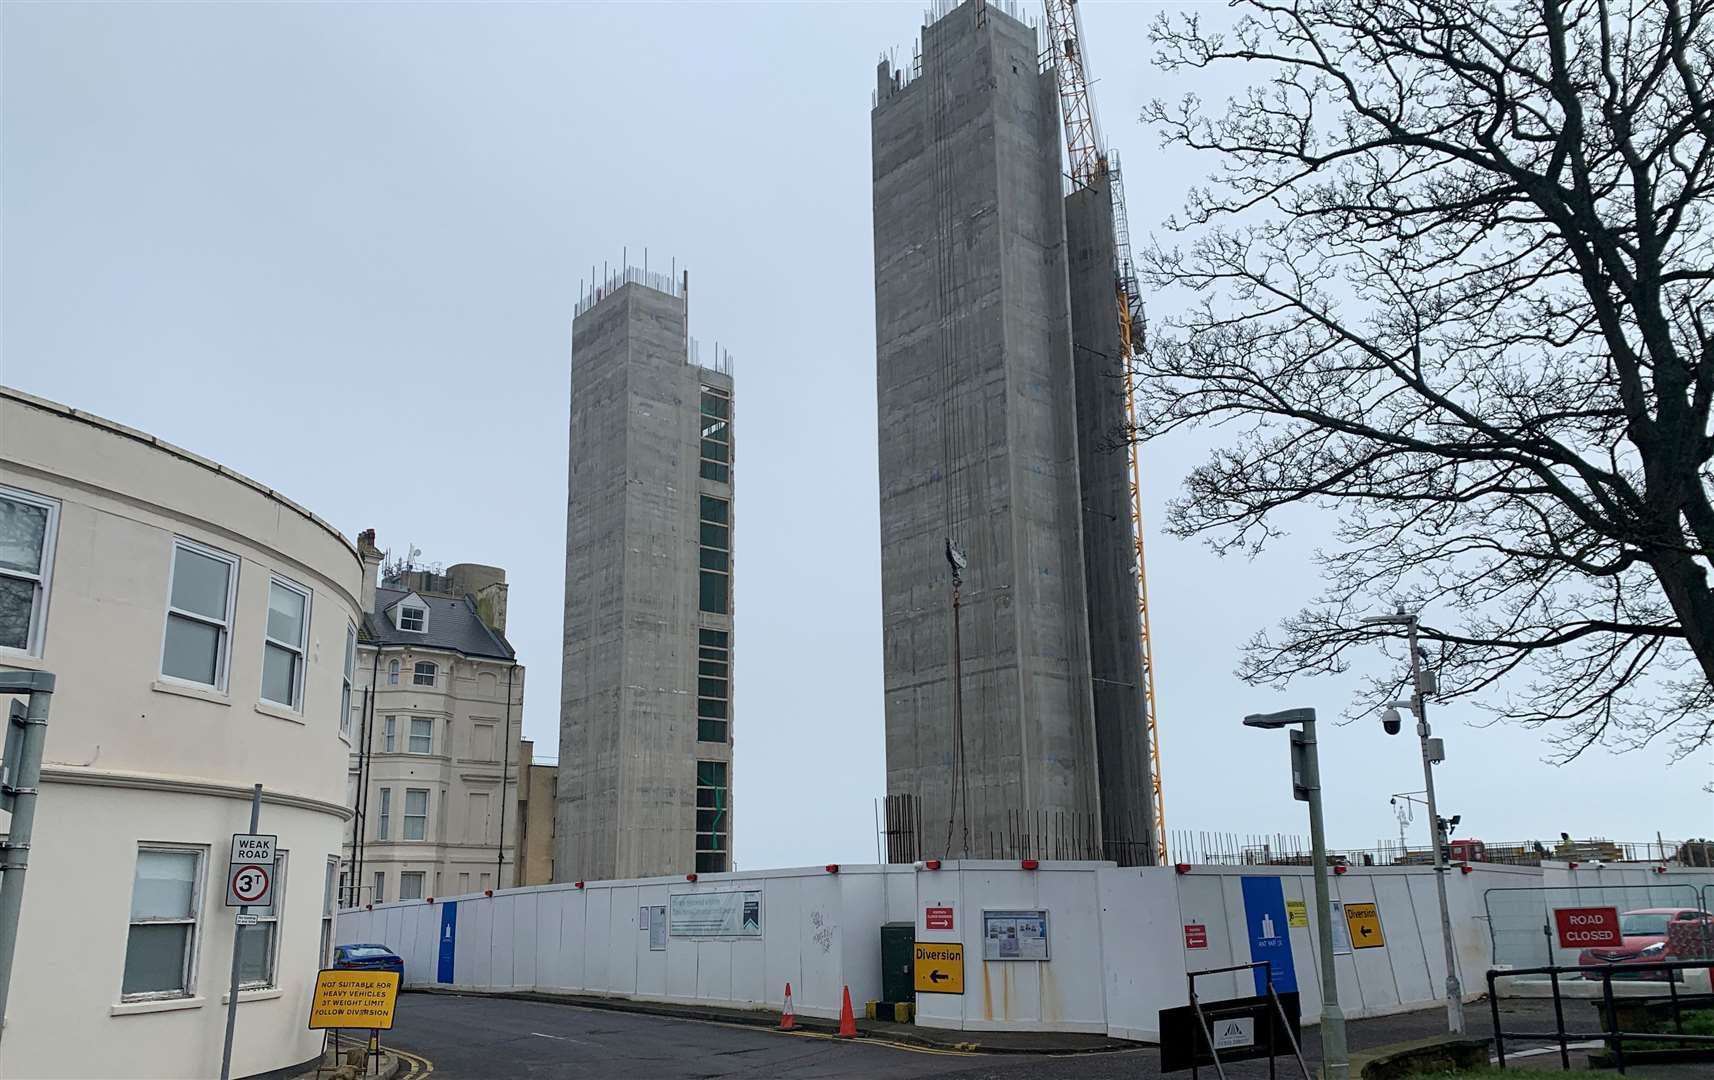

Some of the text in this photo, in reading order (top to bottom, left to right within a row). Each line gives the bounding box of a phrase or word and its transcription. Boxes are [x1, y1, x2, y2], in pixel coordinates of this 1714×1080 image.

[239, 840, 270, 849] WEAK
[238, 850, 268, 859] ROAD
[239, 875, 261, 892] 3T
[1347, 909, 1376, 919] Diversion
[1569, 914, 1604, 925] ROAD
[1566, 930, 1614, 941] CLOSED
[916, 948, 961, 960] Diversion
[338, 981, 375, 989] SUITABLE
[346, 1008, 389, 1016] DIVERSION
